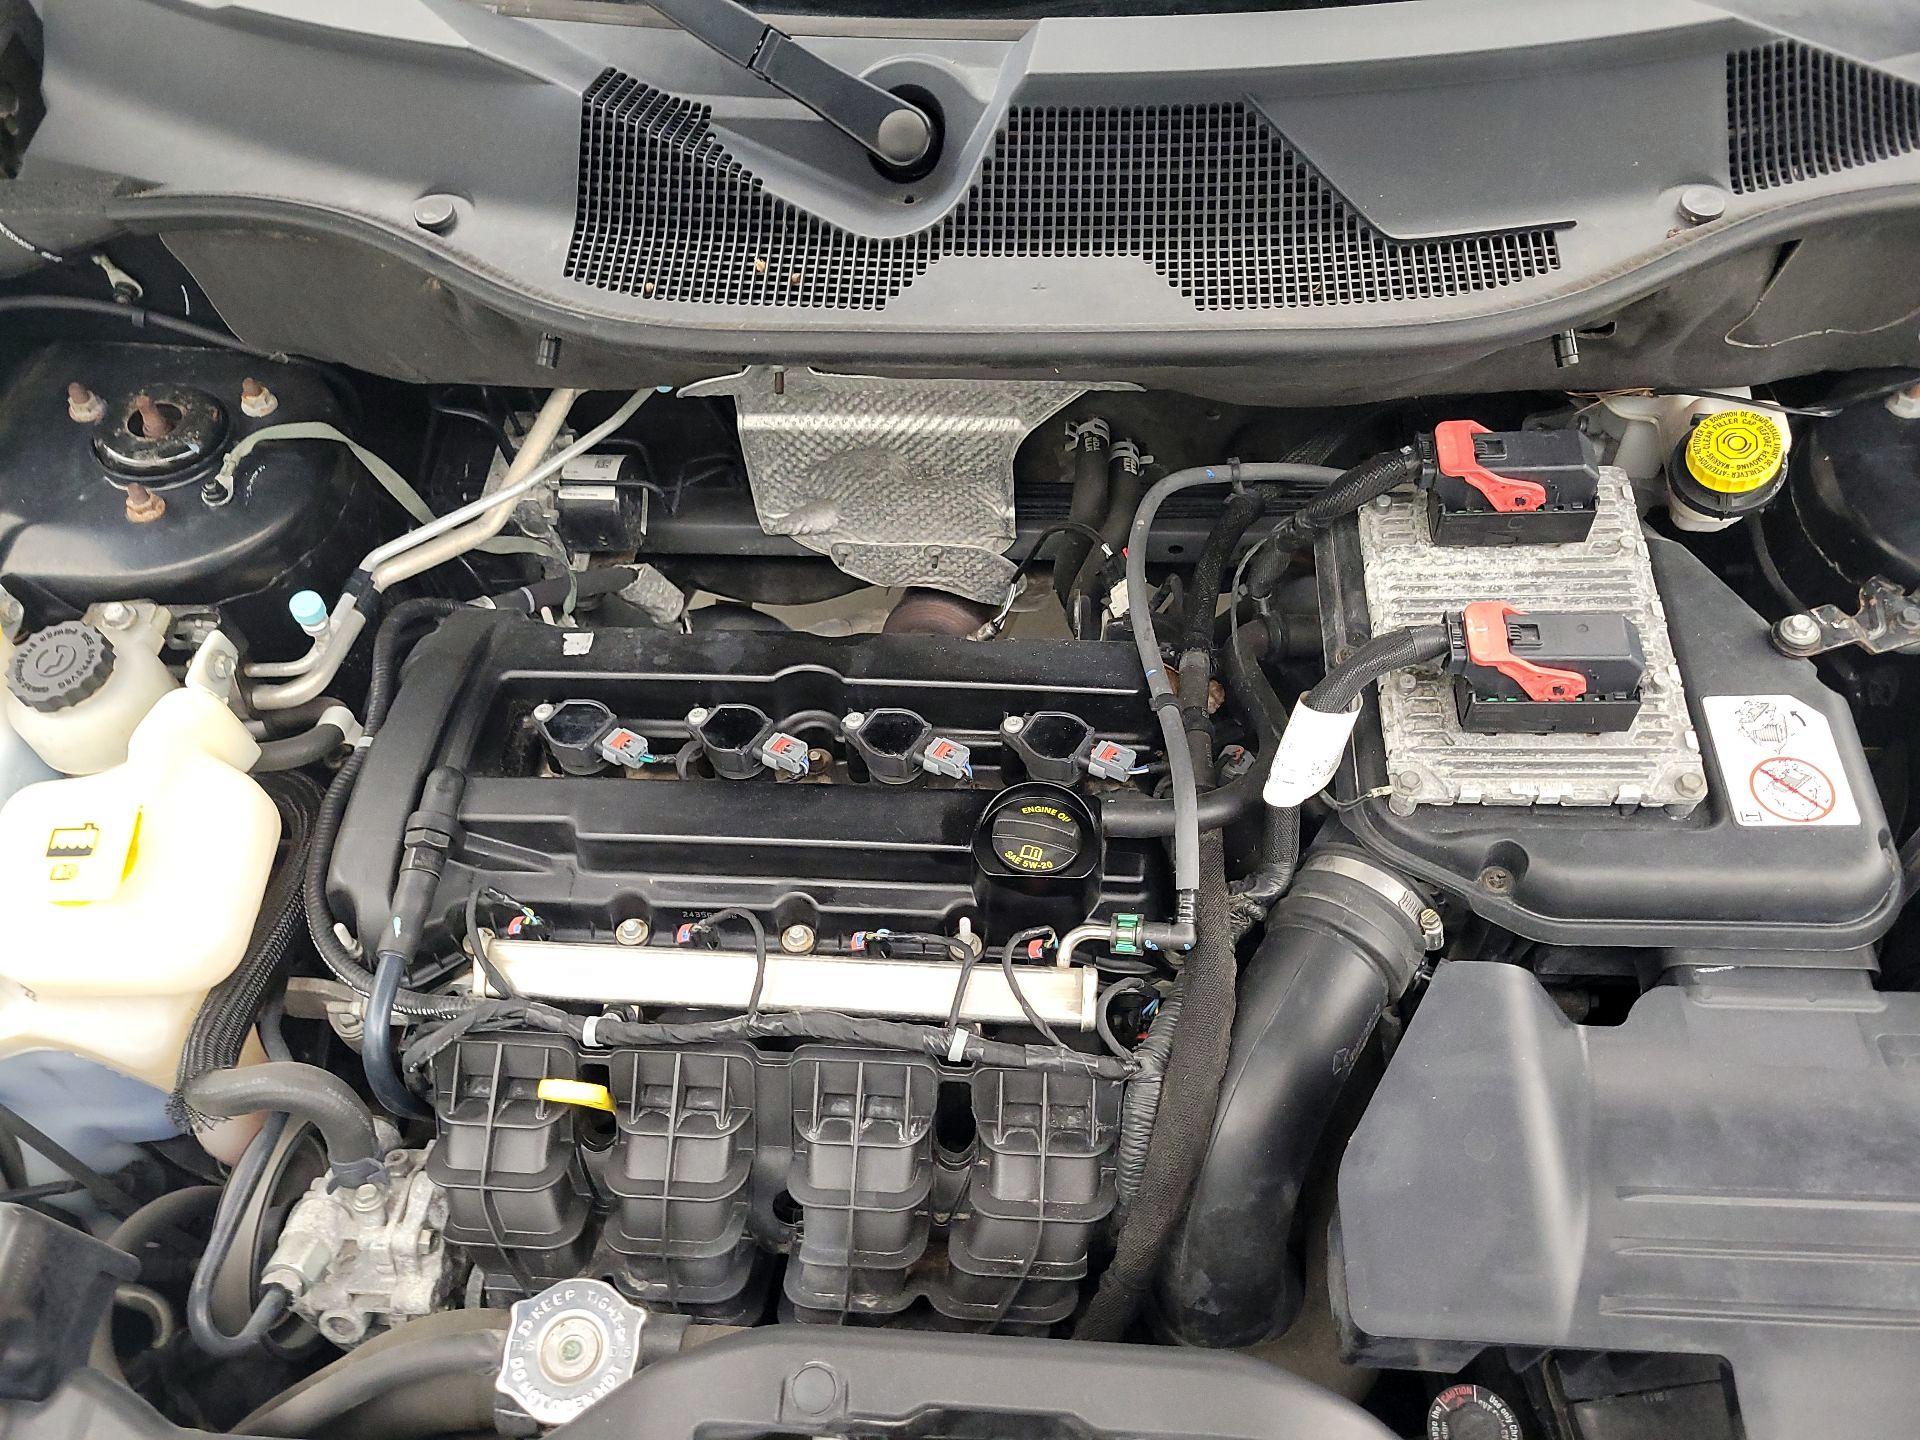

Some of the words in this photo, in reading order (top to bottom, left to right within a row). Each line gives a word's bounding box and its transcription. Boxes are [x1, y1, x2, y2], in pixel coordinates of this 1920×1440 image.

[1711, 418, 1738, 430] FILLER
[1022, 806, 1058, 816] ENGINE
[1057, 812, 1071, 823] OIL
[1004, 850, 1022, 865] SAE
[1022, 861, 1053, 869] 5W-20
[1440, 1387, 1472, 1402] CAUTION
[1431, 1405, 1441, 1419] the
[1489, 1395, 1501, 1408] Use
[1500, 1406, 1513, 1423] only
